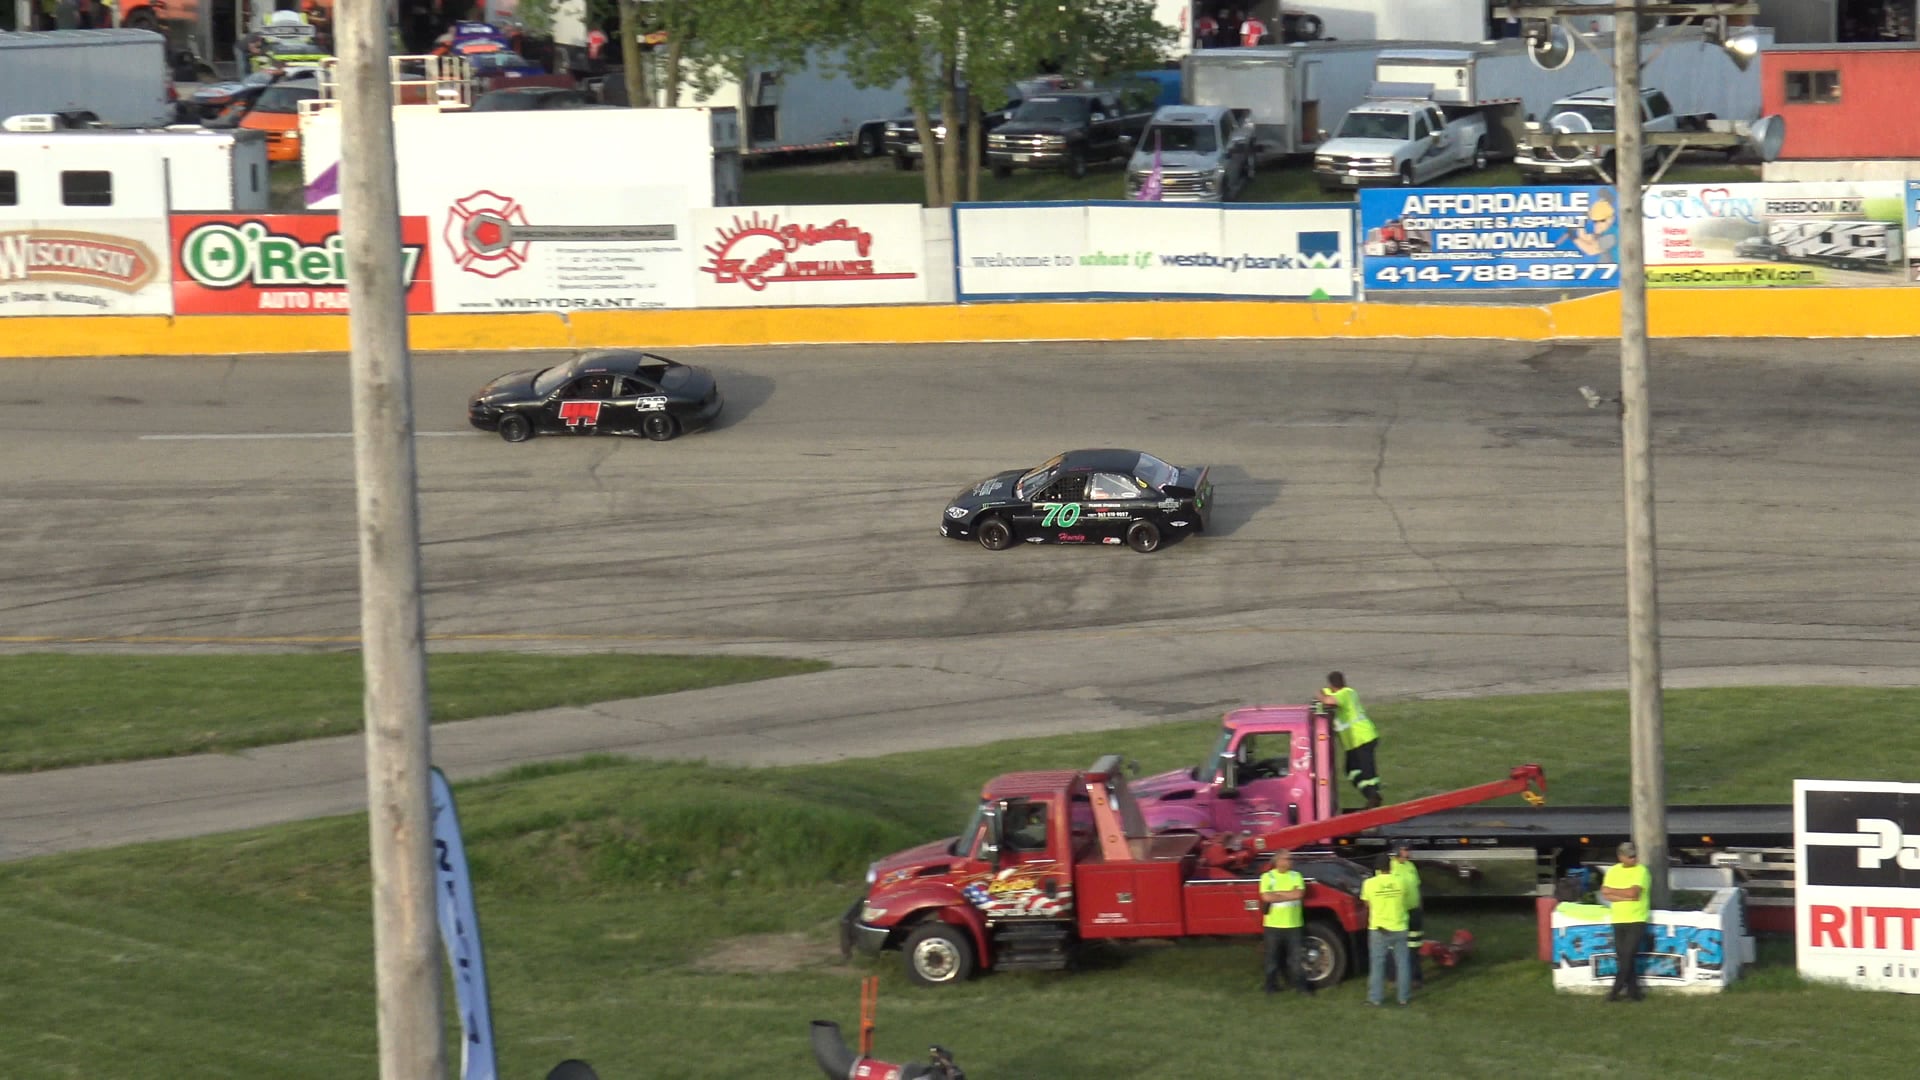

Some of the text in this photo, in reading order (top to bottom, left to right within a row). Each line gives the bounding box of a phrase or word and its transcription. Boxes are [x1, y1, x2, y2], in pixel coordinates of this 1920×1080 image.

[1402, 193, 1589, 214] AFFORDABLE
[1767, 200, 1833, 213] FREEDOM
[1402, 215, 1588, 230] CONCRETE & ASPHALT
[1663, 227, 1686, 236] New
[1436, 231, 1556, 250] REMOVAL
[971, 250, 1153, 269] welcome to what if
[1376, 263, 1619, 284] 414-788-8277
[259, 292, 351, 309] AUTO PAR
[1042, 502, 1081, 529] 70
[1810, 904, 1920, 951] RITT
[1856, 965, 1867, 977] a
